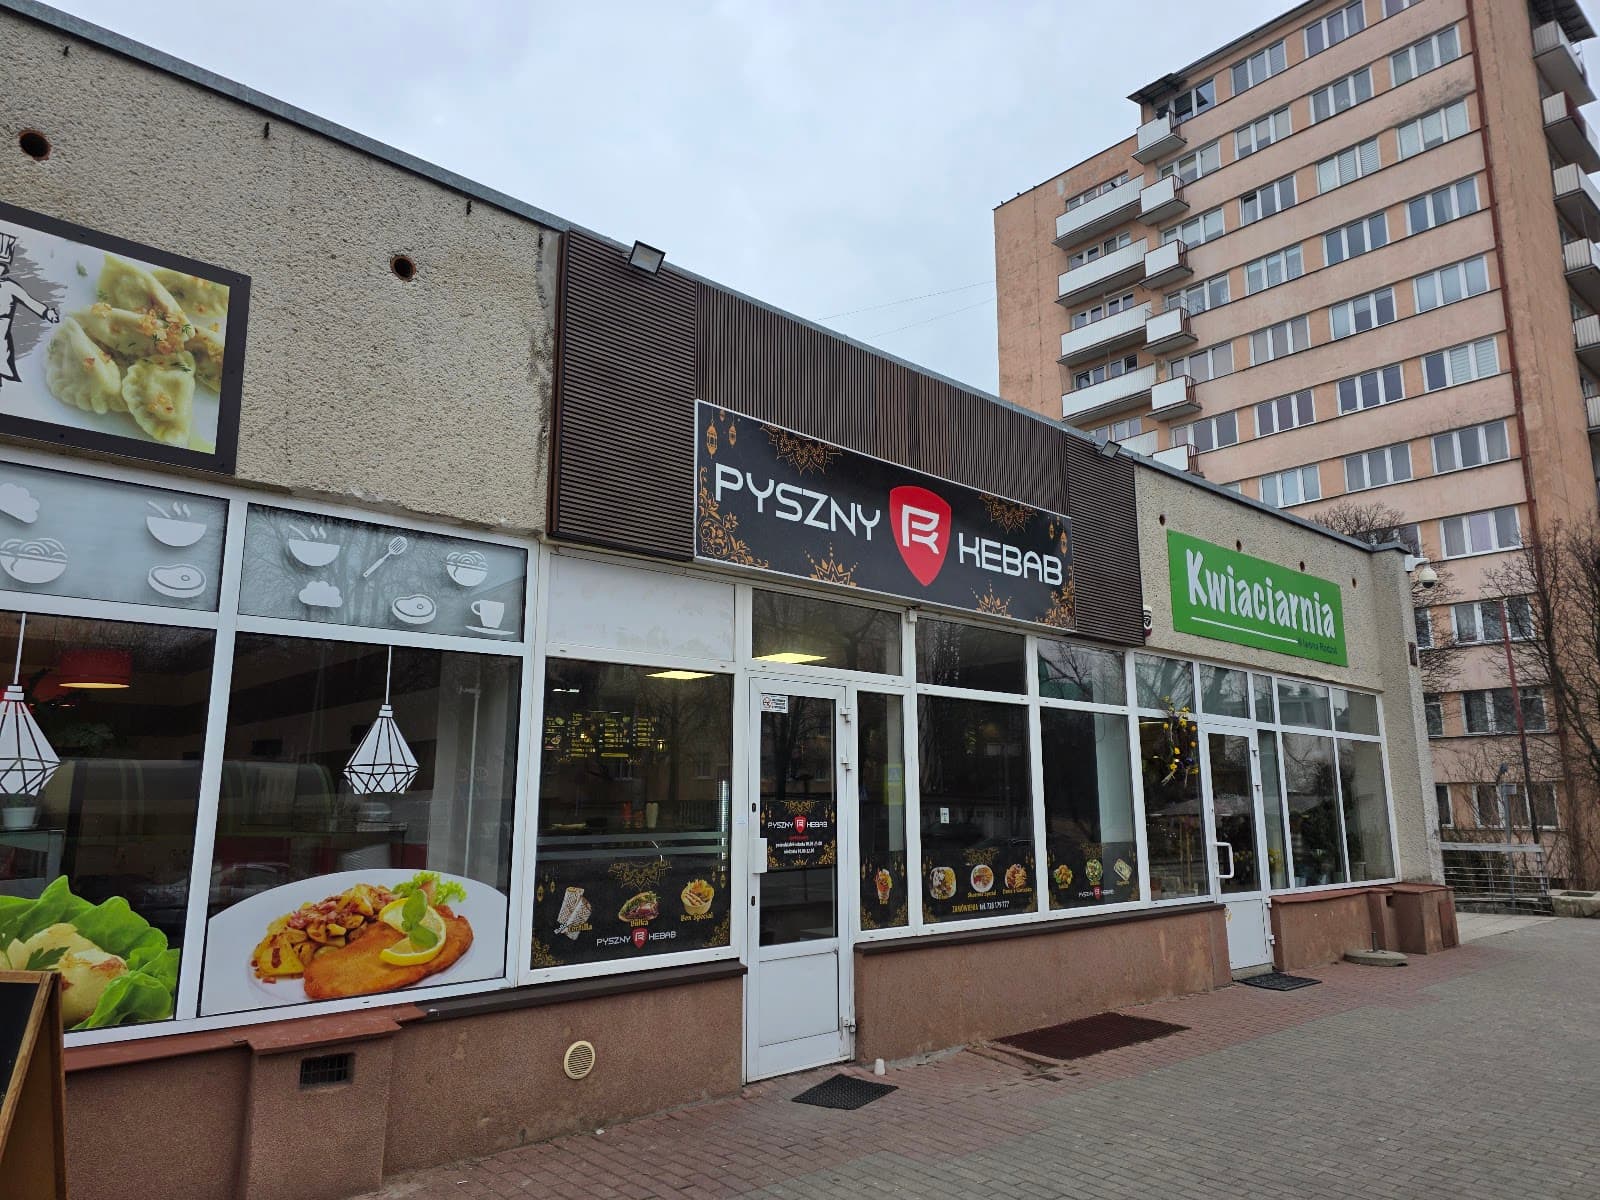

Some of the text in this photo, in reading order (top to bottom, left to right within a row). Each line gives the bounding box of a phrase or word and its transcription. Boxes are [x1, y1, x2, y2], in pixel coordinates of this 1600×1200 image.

[715, 463, 881, 541] PYSZNY
[958, 532, 1063, 586] KEBAB
[1185, 548, 1336, 639] Kwiaciarnia
[767, 821, 793, 829] PYSZNY
[596, 935, 631, 947] PYSZNY
[648, 930, 677, 941] KEBAB
